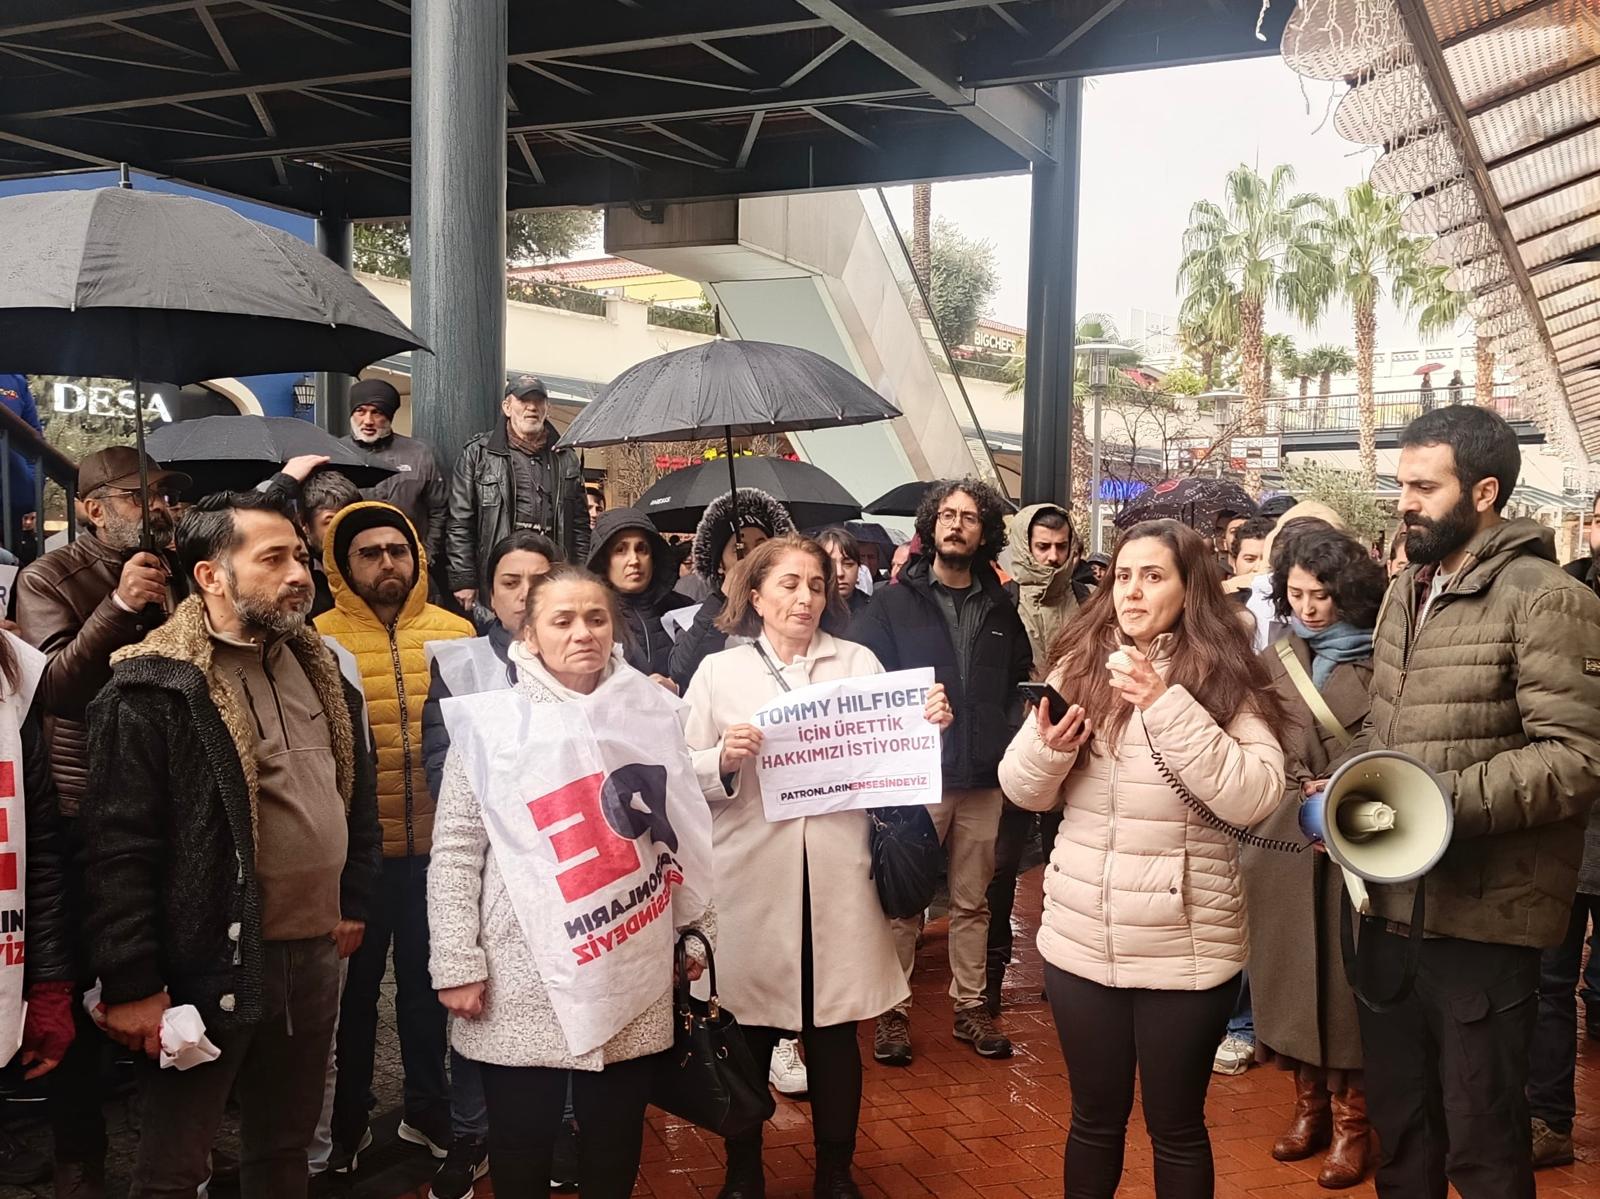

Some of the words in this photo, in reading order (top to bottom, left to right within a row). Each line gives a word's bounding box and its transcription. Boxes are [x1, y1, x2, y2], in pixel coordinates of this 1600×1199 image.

[53, 383, 173, 422] DESA
[756, 699, 831, 726] TOMMY
[798, 721, 831, 743] İÇİN
[835, 714, 904, 738] ÜRETTİK
[762, 745, 844, 770] HAKKIMIZI
[847, 735, 936, 757] İSTİYORUZ!
